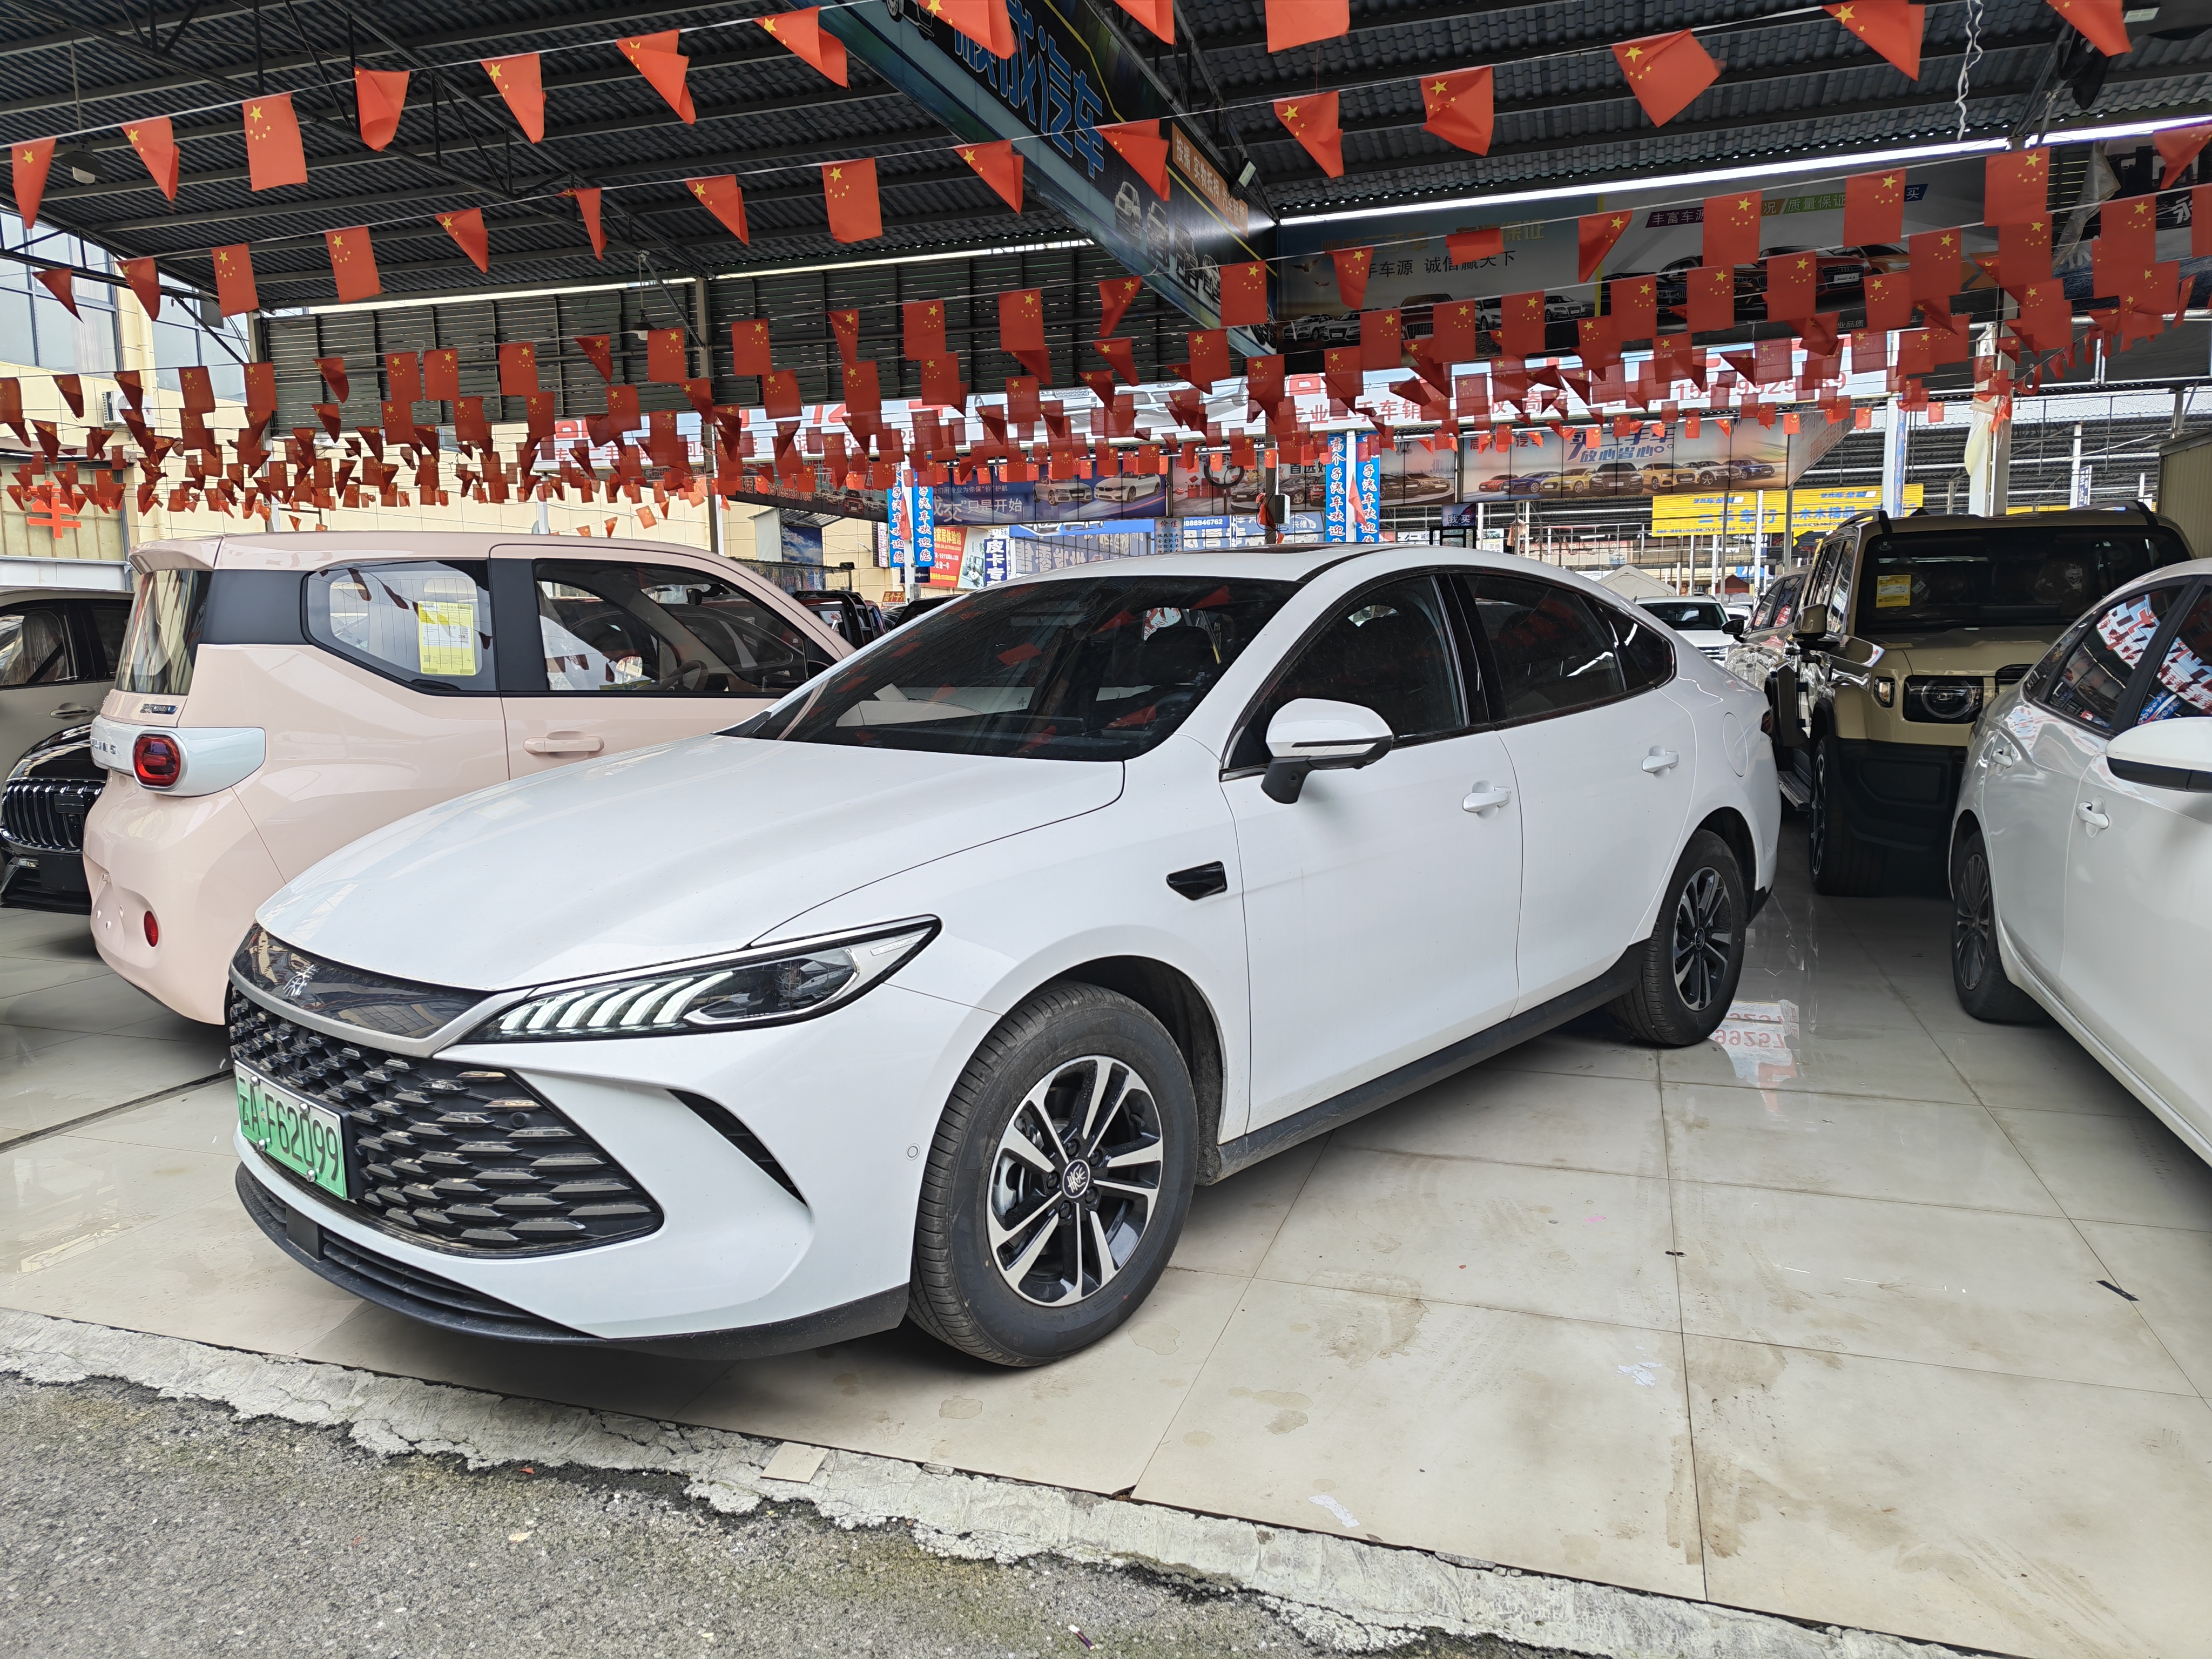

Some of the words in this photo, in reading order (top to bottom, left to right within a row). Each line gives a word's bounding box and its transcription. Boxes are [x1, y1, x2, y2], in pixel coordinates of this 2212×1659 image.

[1906, 187, 1920, 200] 买
[1787, 195, 1845, 211] 质量保证
[1580, 444, 1655, 463] 放心省心
[1358, 449, 1378, 542] 子汽车欢迎
[890, 475, 905, 563] 子汽车欢迎您
[1161, 520, 1178, 528] 价值
